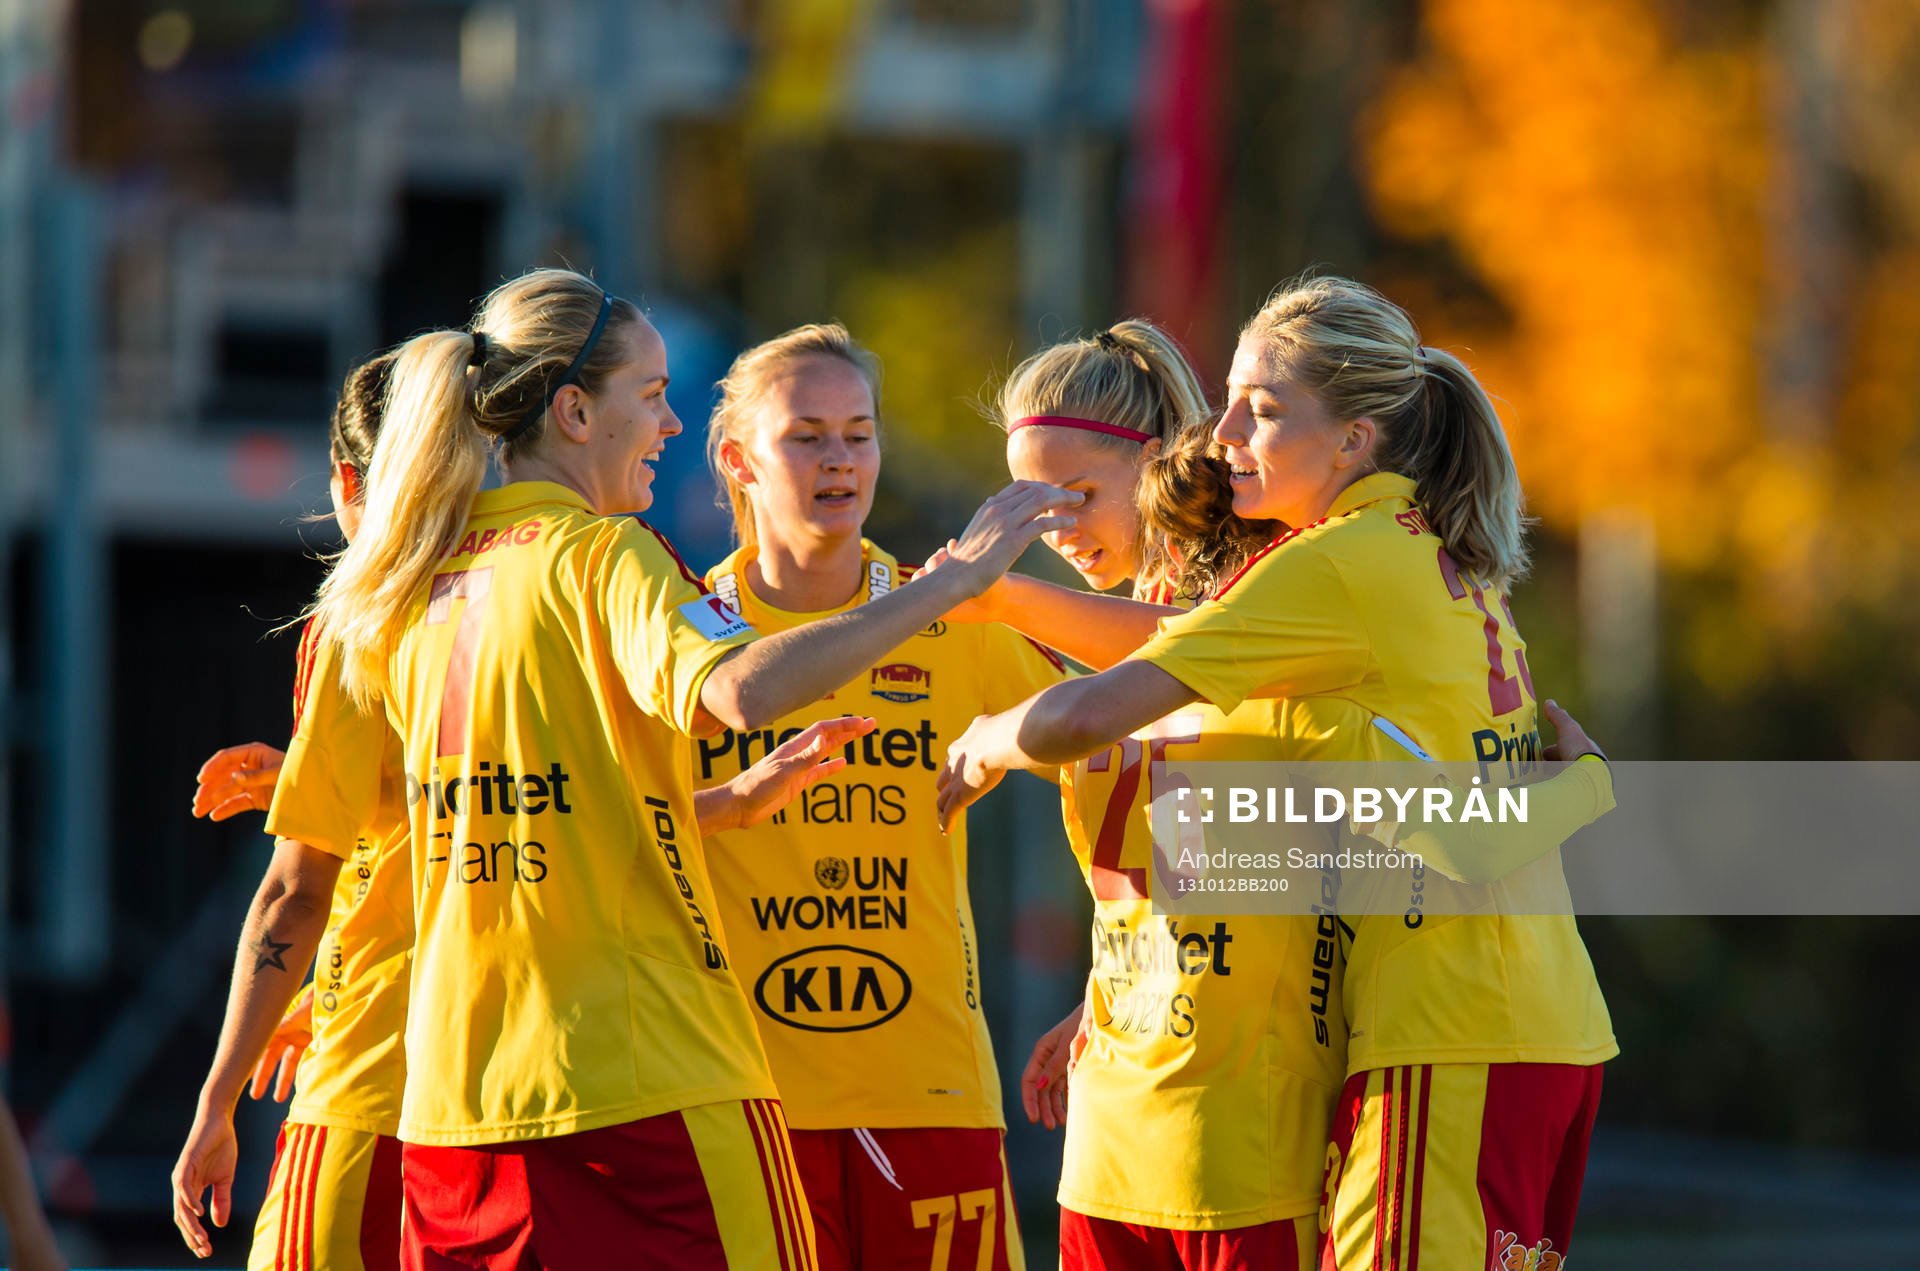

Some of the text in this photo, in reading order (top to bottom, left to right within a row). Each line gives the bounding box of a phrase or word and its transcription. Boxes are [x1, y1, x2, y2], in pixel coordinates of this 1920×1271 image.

[439, 520, 543, 559] ABAG
[425, 565, 495, 758] 7
[853, 856, 909, 892] UN
[750, 895, 908, 931] WOMEN
[780, 965, 889, 1013] KIA
[910, 1187, 997, 1271] 77
